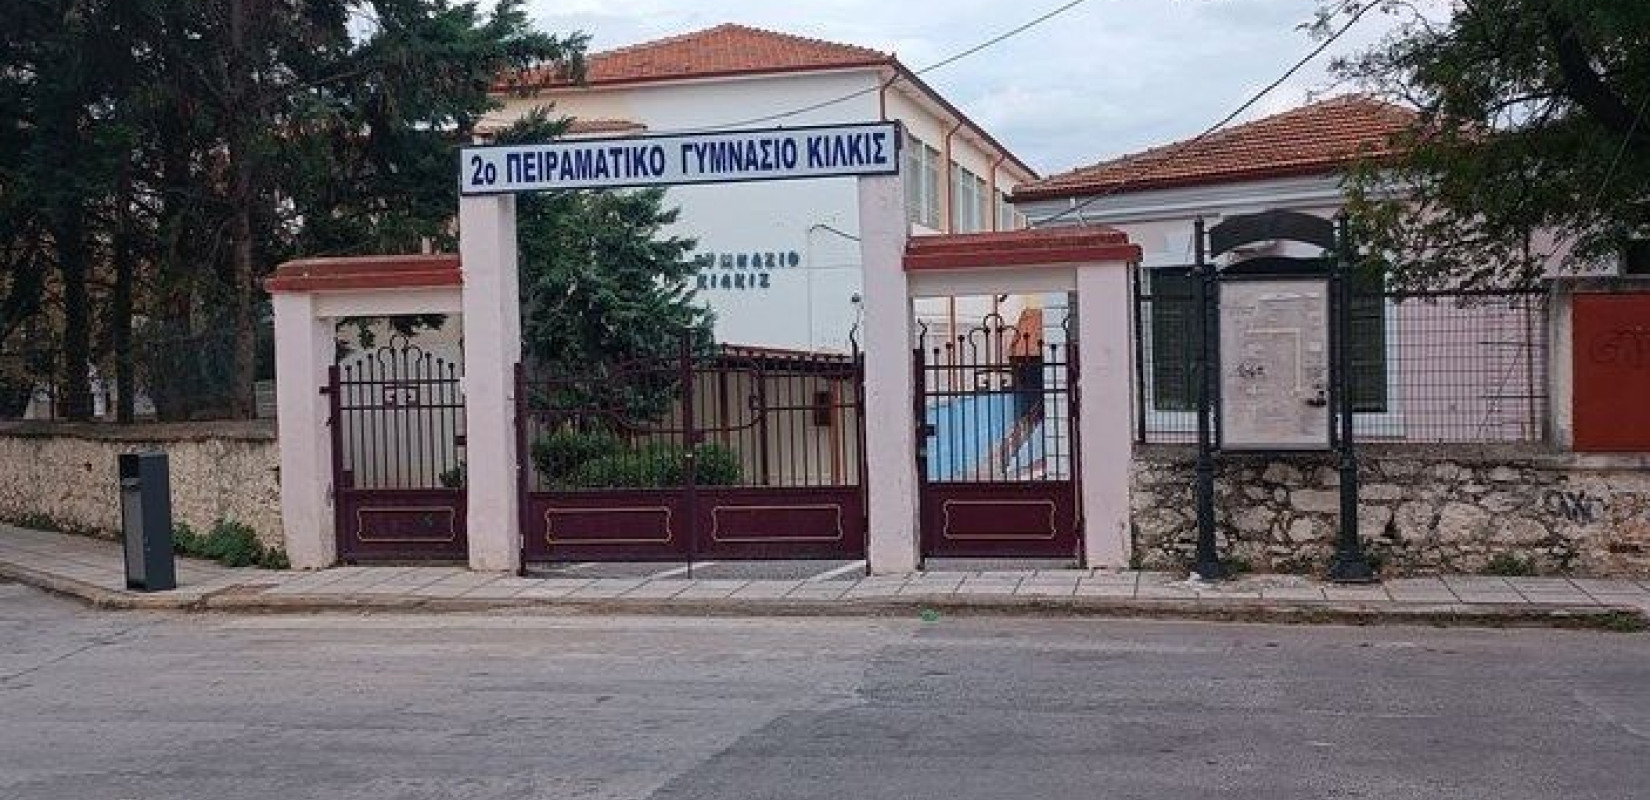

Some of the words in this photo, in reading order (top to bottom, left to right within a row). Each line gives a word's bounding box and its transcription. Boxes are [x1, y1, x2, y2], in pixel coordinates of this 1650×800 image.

[471, 154, 496, 185] 2ο
[506, 144, 665, 183] ΠΕΙΡΑΜΑΤΙΚΟ
[680, 137, 797, 174] ΓΥΜΝΑΣΙΟ
[807, 132, 887, 169] ΚΙΛΚΙΣ
